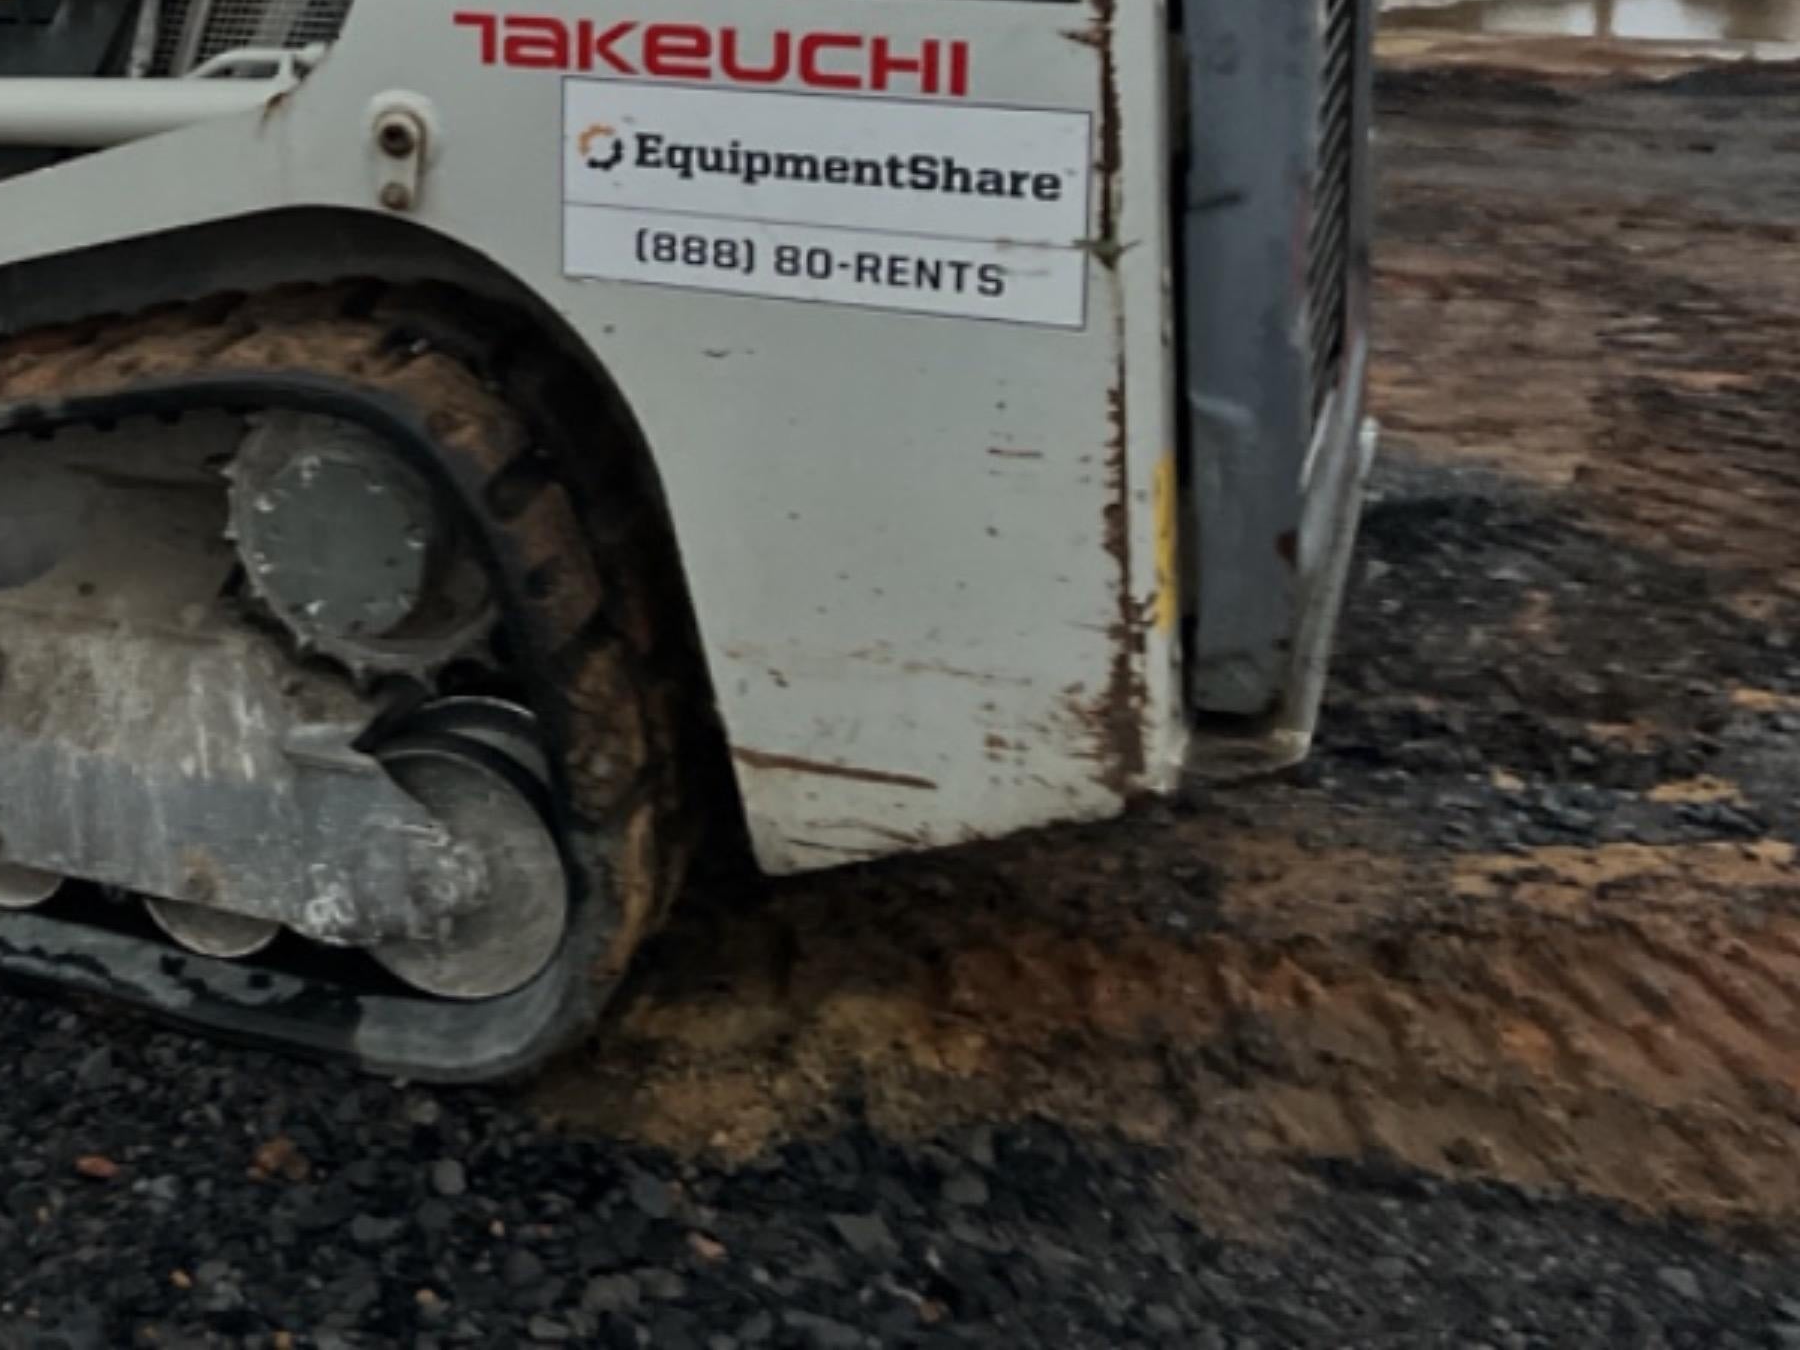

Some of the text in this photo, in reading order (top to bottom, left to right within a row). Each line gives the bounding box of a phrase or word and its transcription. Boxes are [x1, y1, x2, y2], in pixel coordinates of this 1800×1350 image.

[634, 132, 1063, 203] EquipmentShare
[634, 226, 1007, 298] (888) 80-RENTS
